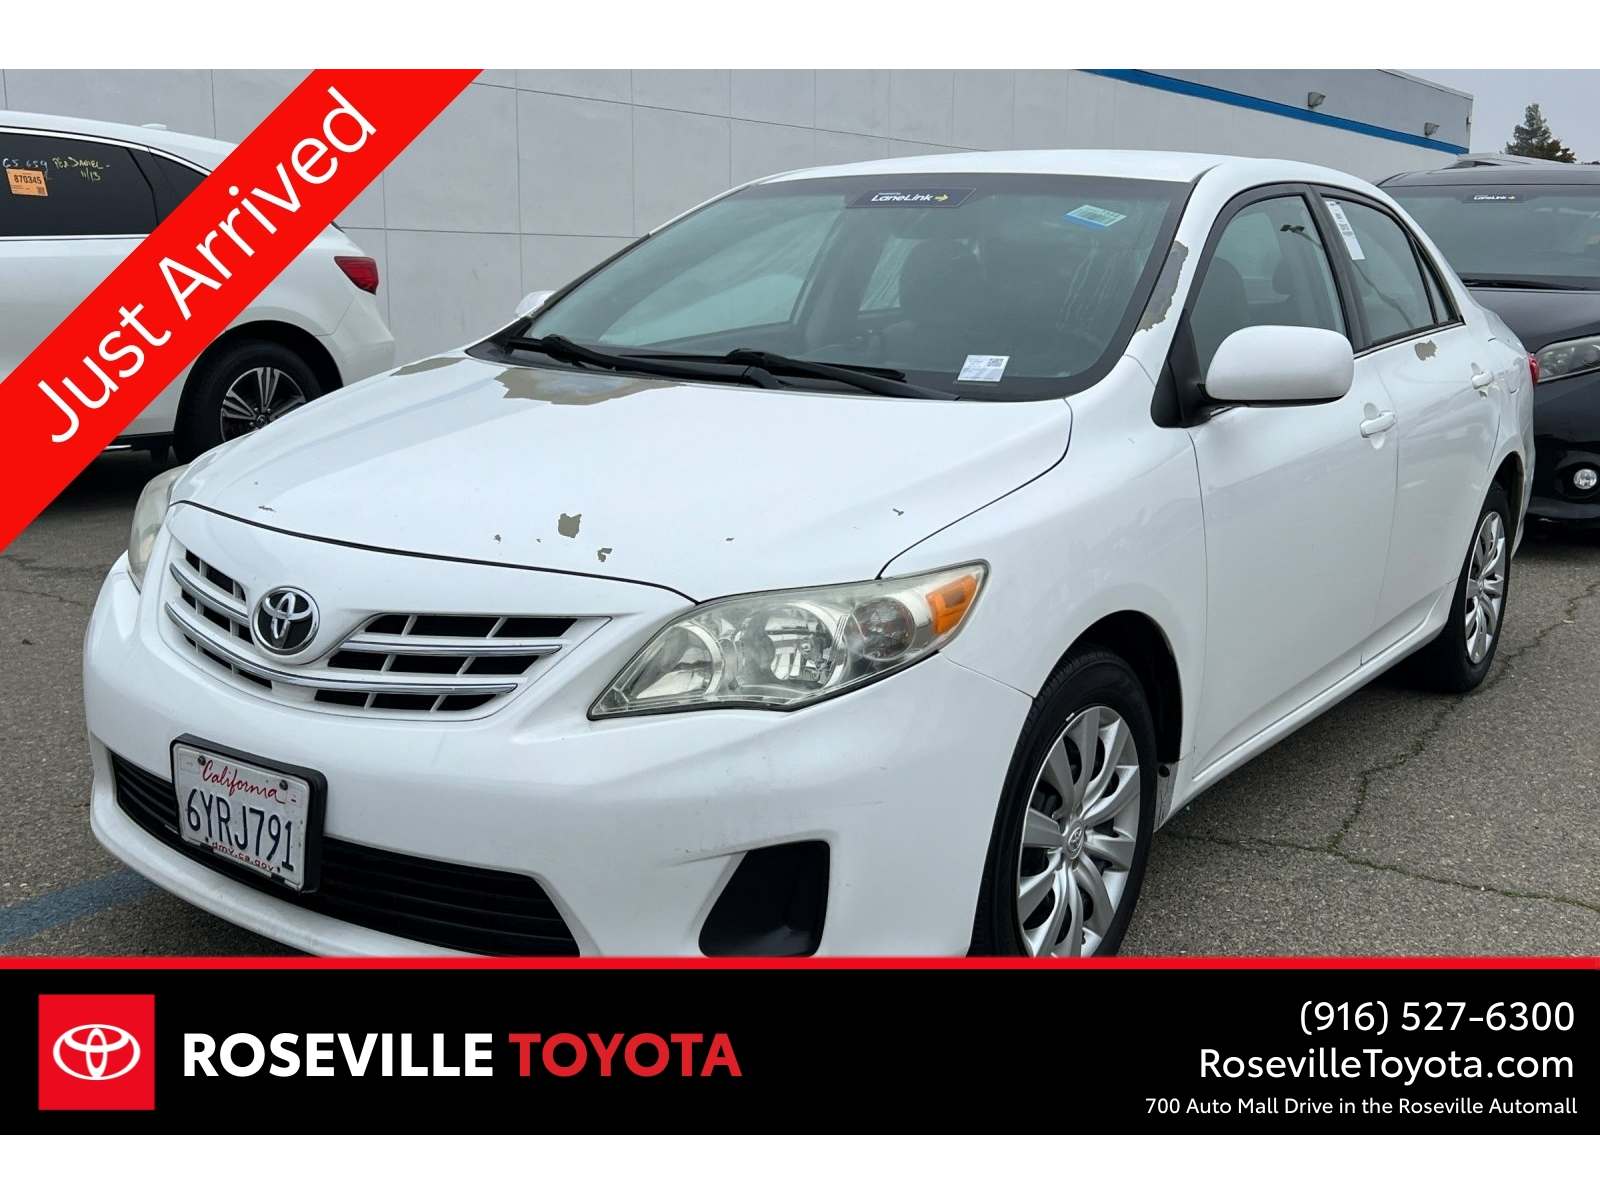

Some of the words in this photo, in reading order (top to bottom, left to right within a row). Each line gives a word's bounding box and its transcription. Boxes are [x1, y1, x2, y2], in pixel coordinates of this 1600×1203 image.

[13, 174, 42, 185] 870345
[871, 194, 933, 202] LaneLink
[202, 760, 287, 804] California
[187, 788, 294, 872] 6YRJ791
[211, 842, 274, 872] dmv.ca.gov
